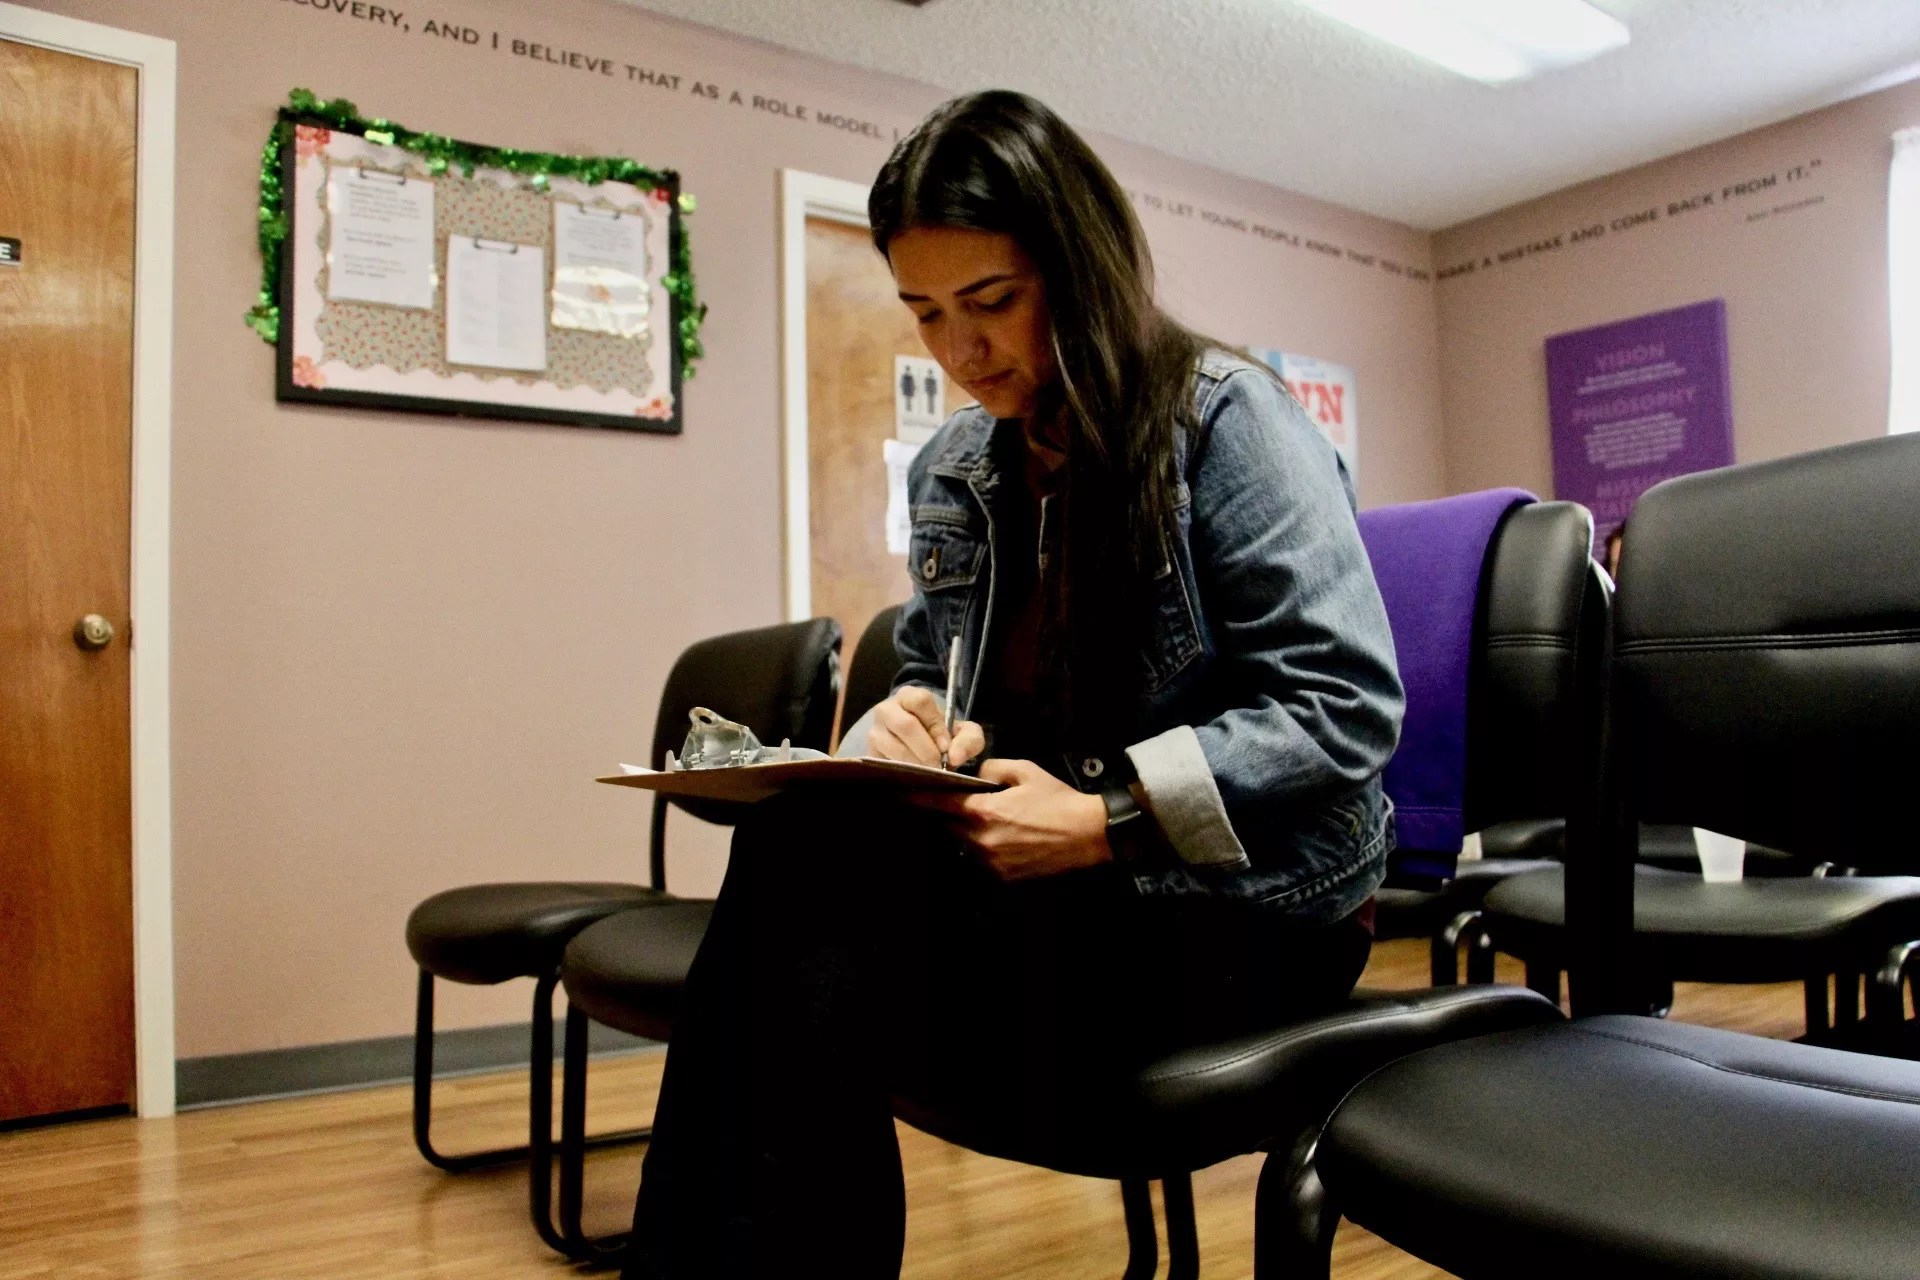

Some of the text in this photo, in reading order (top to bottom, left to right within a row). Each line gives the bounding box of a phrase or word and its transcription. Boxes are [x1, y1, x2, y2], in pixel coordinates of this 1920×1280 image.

[423, 19, 480, 45] AND
[491, 31, 499, 49] I
[511, 39, 614, 76] BELIEVE
[625, 64, 682, 90] THAT
[691, 81, 720, 99] AS
[729, 90, 743, 105] A
[752, 95, 807, 121] ROLE
[1143, 192, 1163, 209] TO
[1167, 202, 1193, 218] LET
[1200, 209, 1249, 233] YOUNG
[1252, 223, 1300, 247] PEOPLE
[1482, 257, 1492, 270] A
[1498, 235, 1564, 263] MISTAKE
[1570, 224, 1606, 243] AND
[1610, 207, 1658, 231] COME
[1667, 193, 1714, 217] BACK
[1722, 174, 1777, 200] FROM
